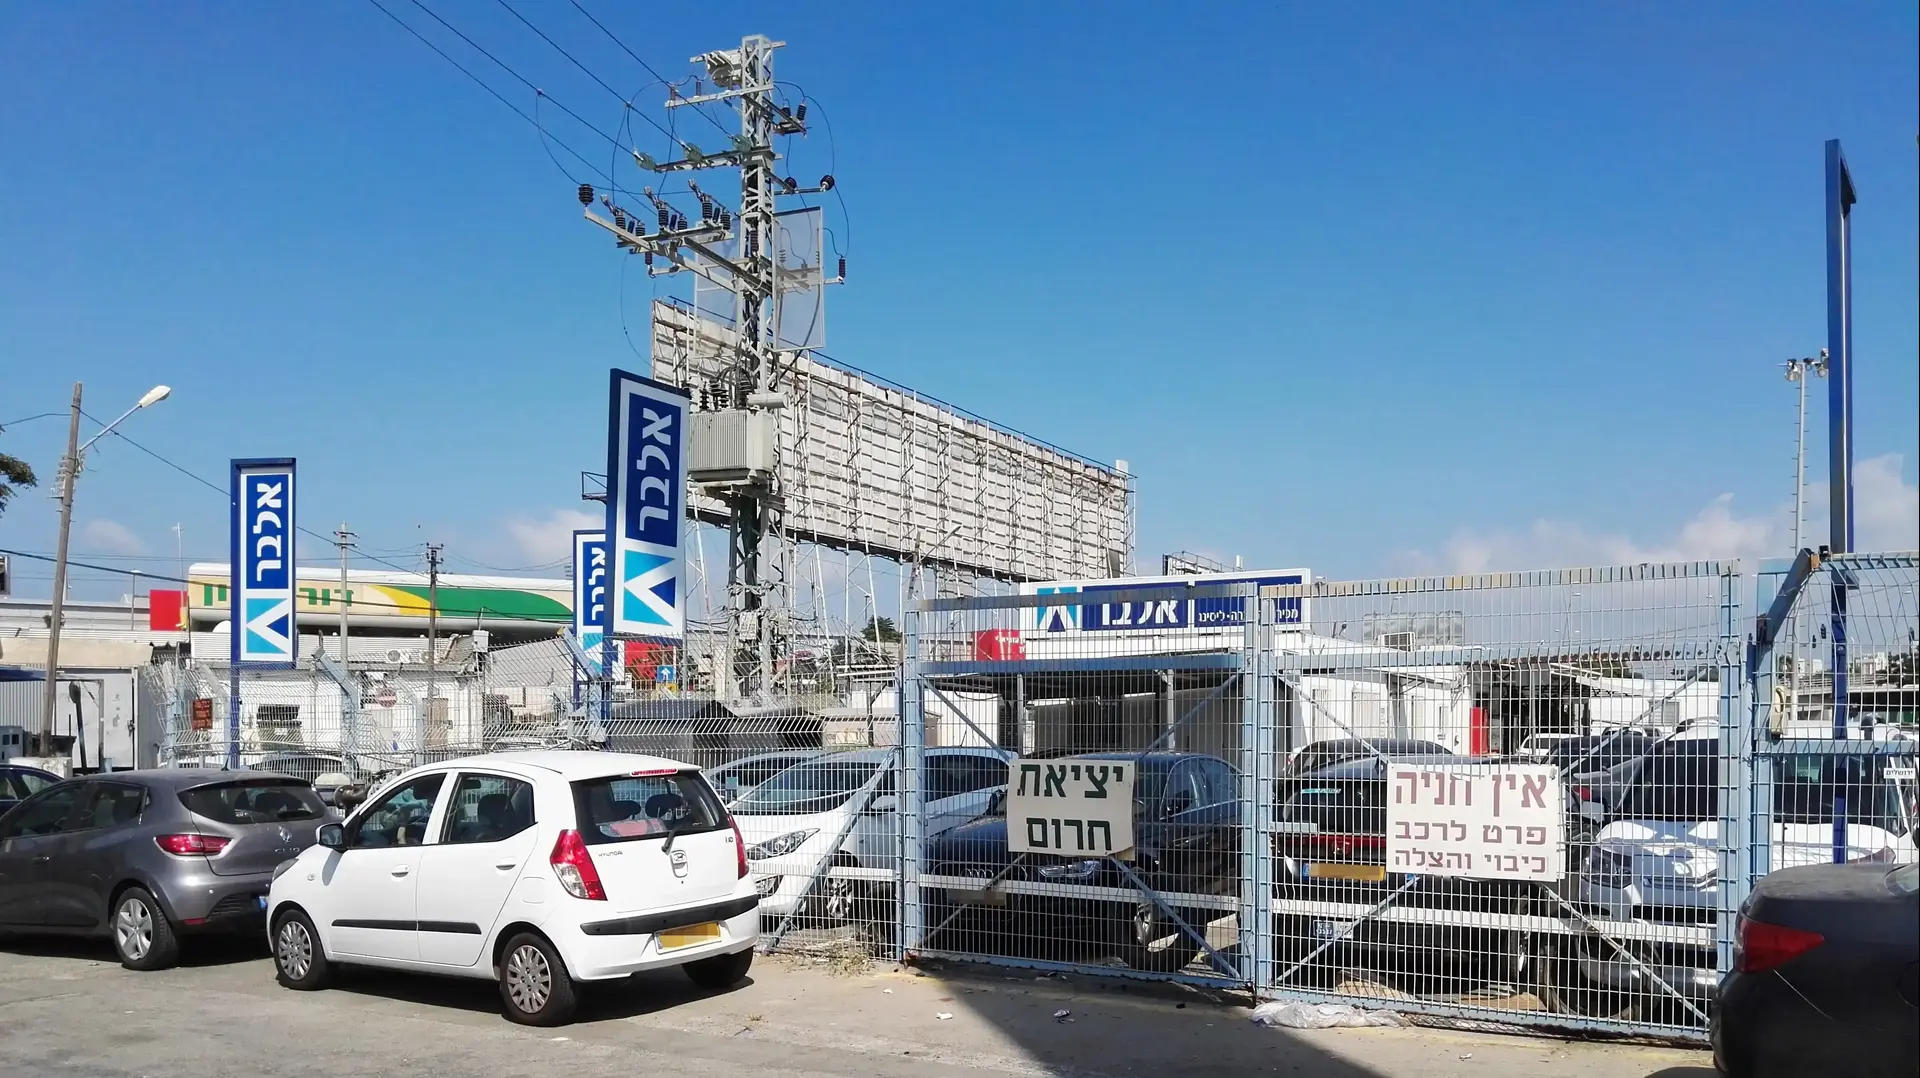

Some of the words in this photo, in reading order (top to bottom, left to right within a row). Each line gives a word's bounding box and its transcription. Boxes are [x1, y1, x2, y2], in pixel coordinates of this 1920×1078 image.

[636, 407, 672, 532] אלבר
[252, 482, 282, 582] אלבר
[1017, 763, 1124, 799] יציאת
[1396, 771, 1472, 807] חניה
[1491, 773, 1547, 818] אין
[1026, 817, 1112, 851] חרום
[1395, 819, 1467, 842] לרכב
[1482, 824, 1547, 846] פרט
[1395, 847, 1472, 870] והצלה
[1483, 854, 1546, 874] כיבוי
